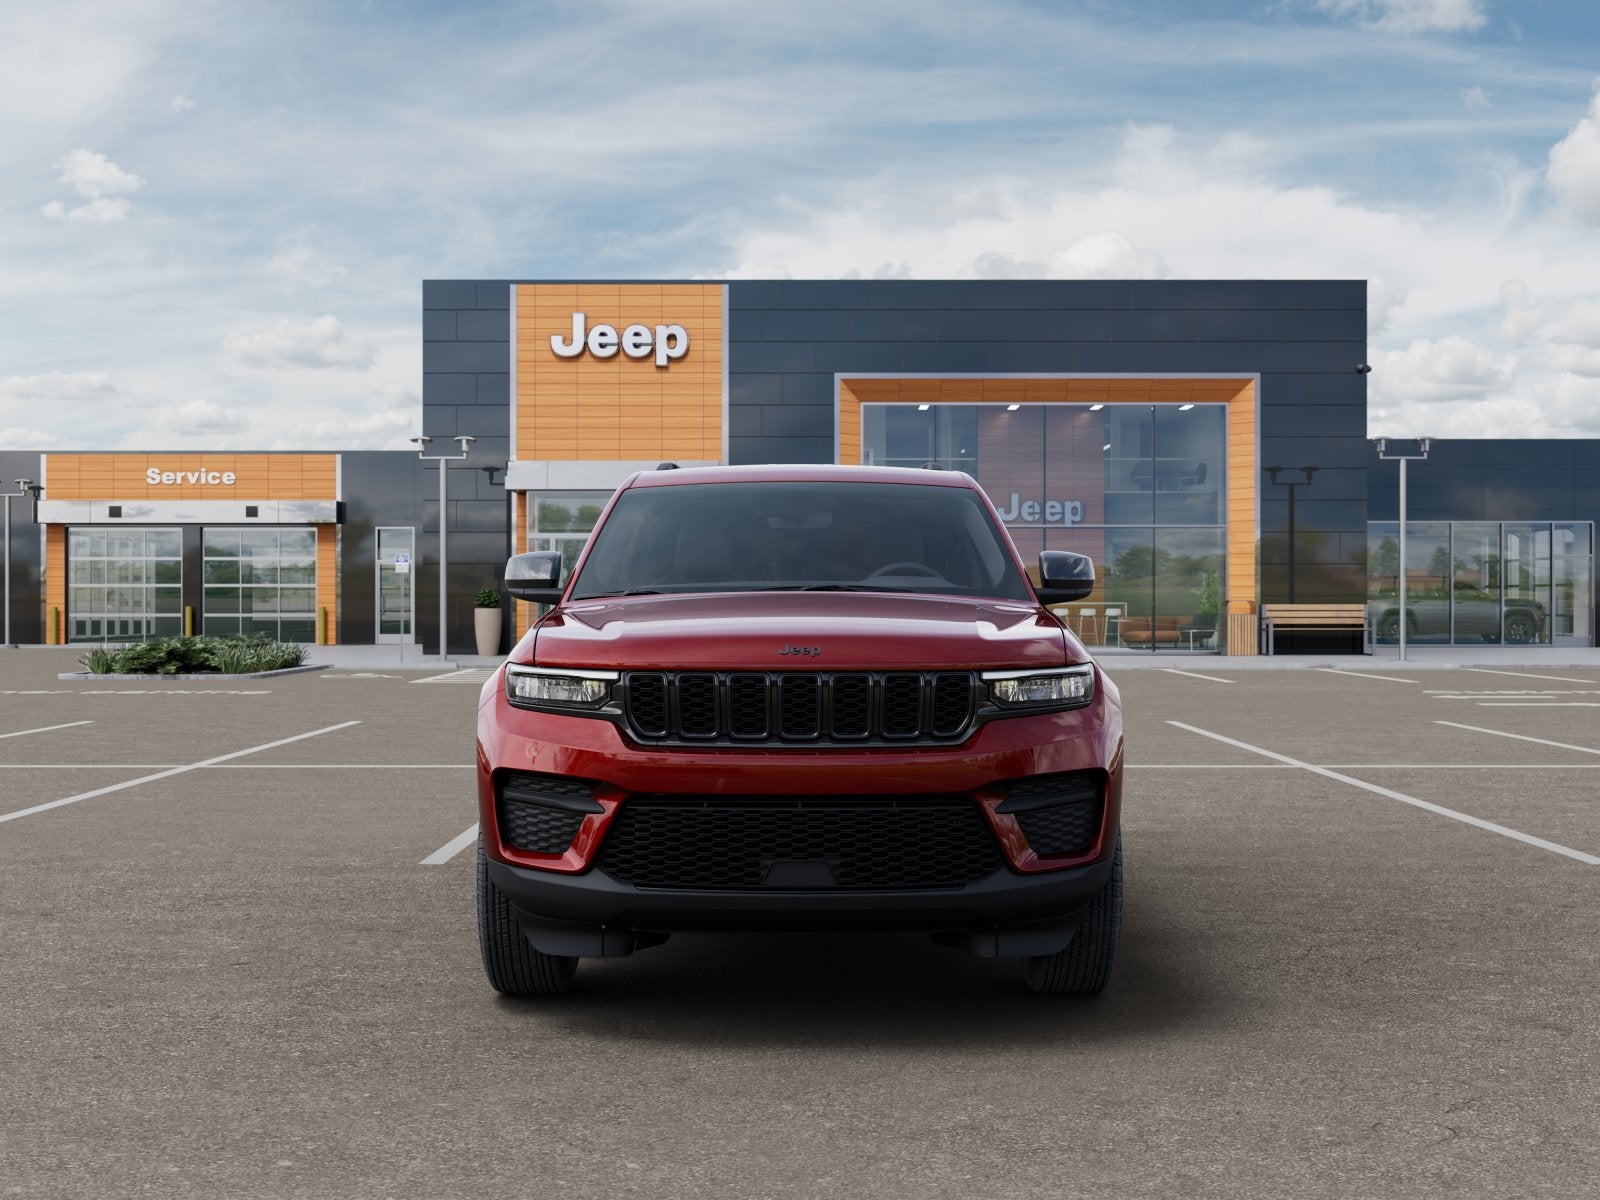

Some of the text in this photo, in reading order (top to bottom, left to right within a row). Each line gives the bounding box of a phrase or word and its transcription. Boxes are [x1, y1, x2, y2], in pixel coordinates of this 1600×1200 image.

[550, 312, 689, 367] Jeep
[146, 467, 237, 485] Service
[997, 493, 1084, 526] Jeep
[778, 643, 822, 657] Jeep
